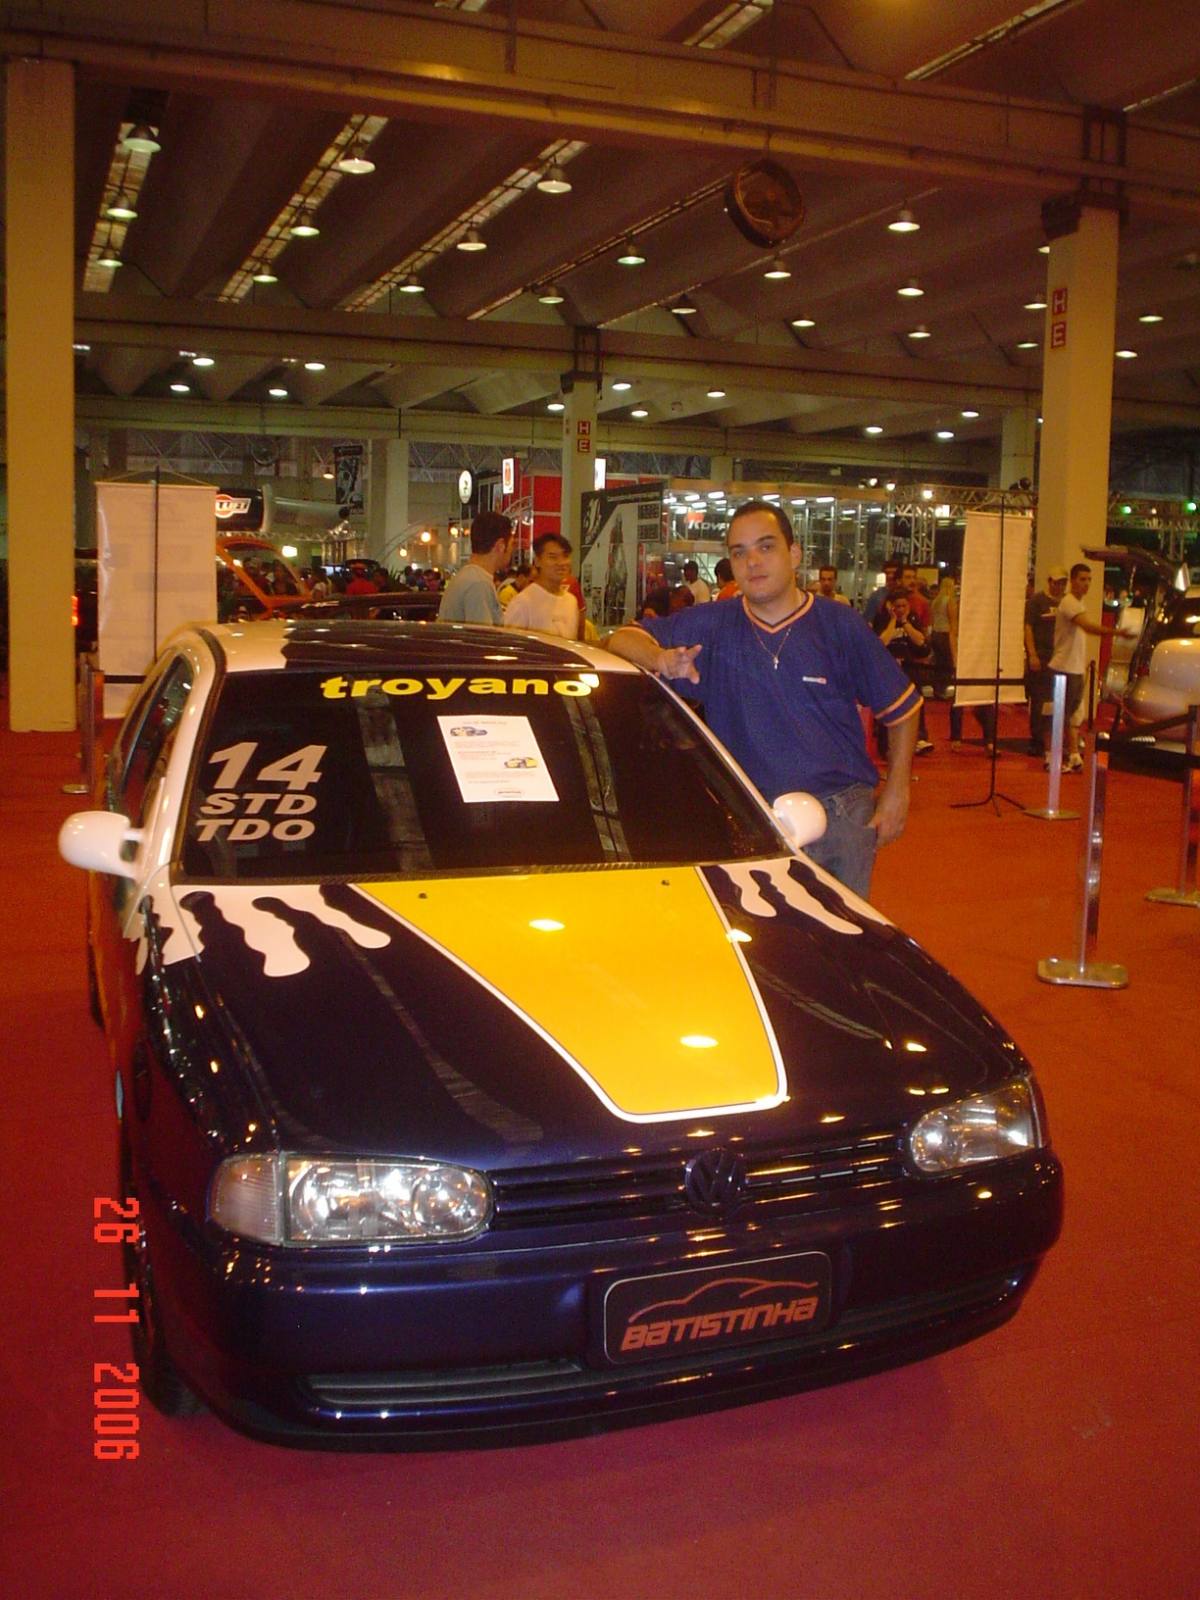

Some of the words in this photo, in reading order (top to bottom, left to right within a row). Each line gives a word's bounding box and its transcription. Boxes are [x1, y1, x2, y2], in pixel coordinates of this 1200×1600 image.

[320, 674, 593, 701] troyano
[208, 742, 328, 792] 14
[198, 793, 317, 816] STD
[194, 818, 315, 842] TDO
